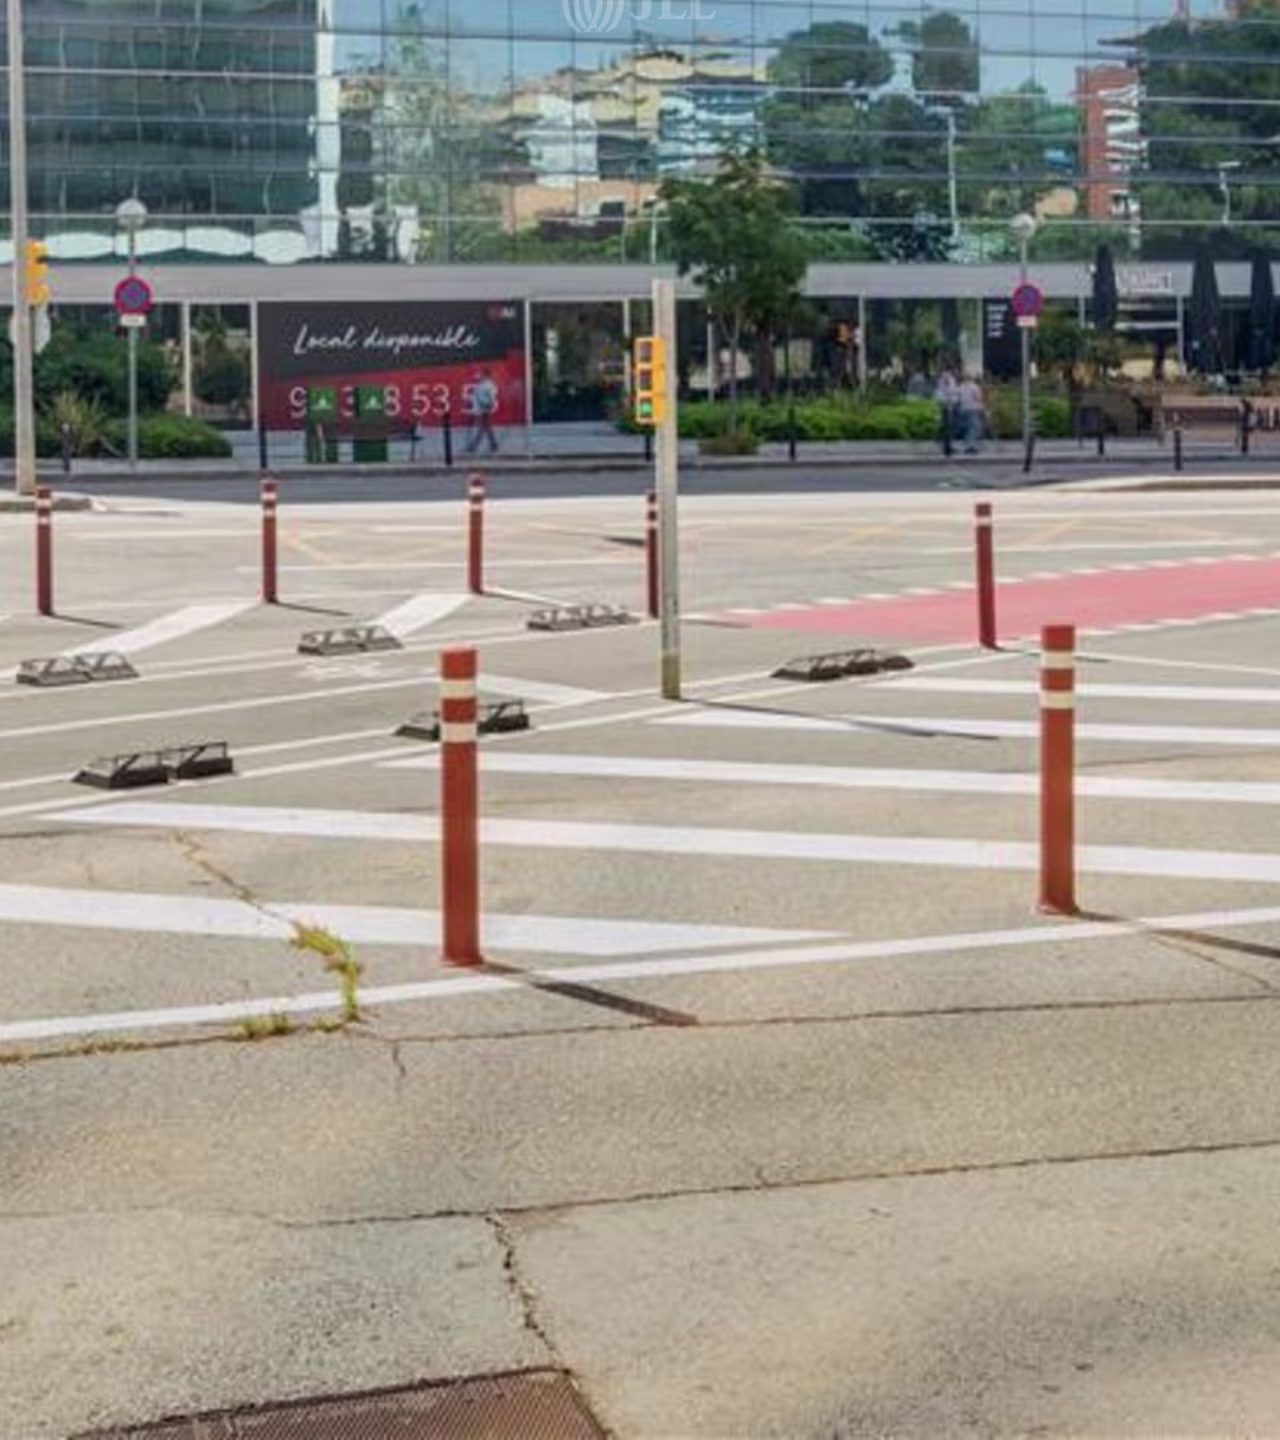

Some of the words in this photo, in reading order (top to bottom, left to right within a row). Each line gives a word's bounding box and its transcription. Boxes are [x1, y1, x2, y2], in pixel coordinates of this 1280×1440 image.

[293, 324, 356, 355] Local
[362, 325, 480, 355] disponible
[412, 383, 450, 417] 53
